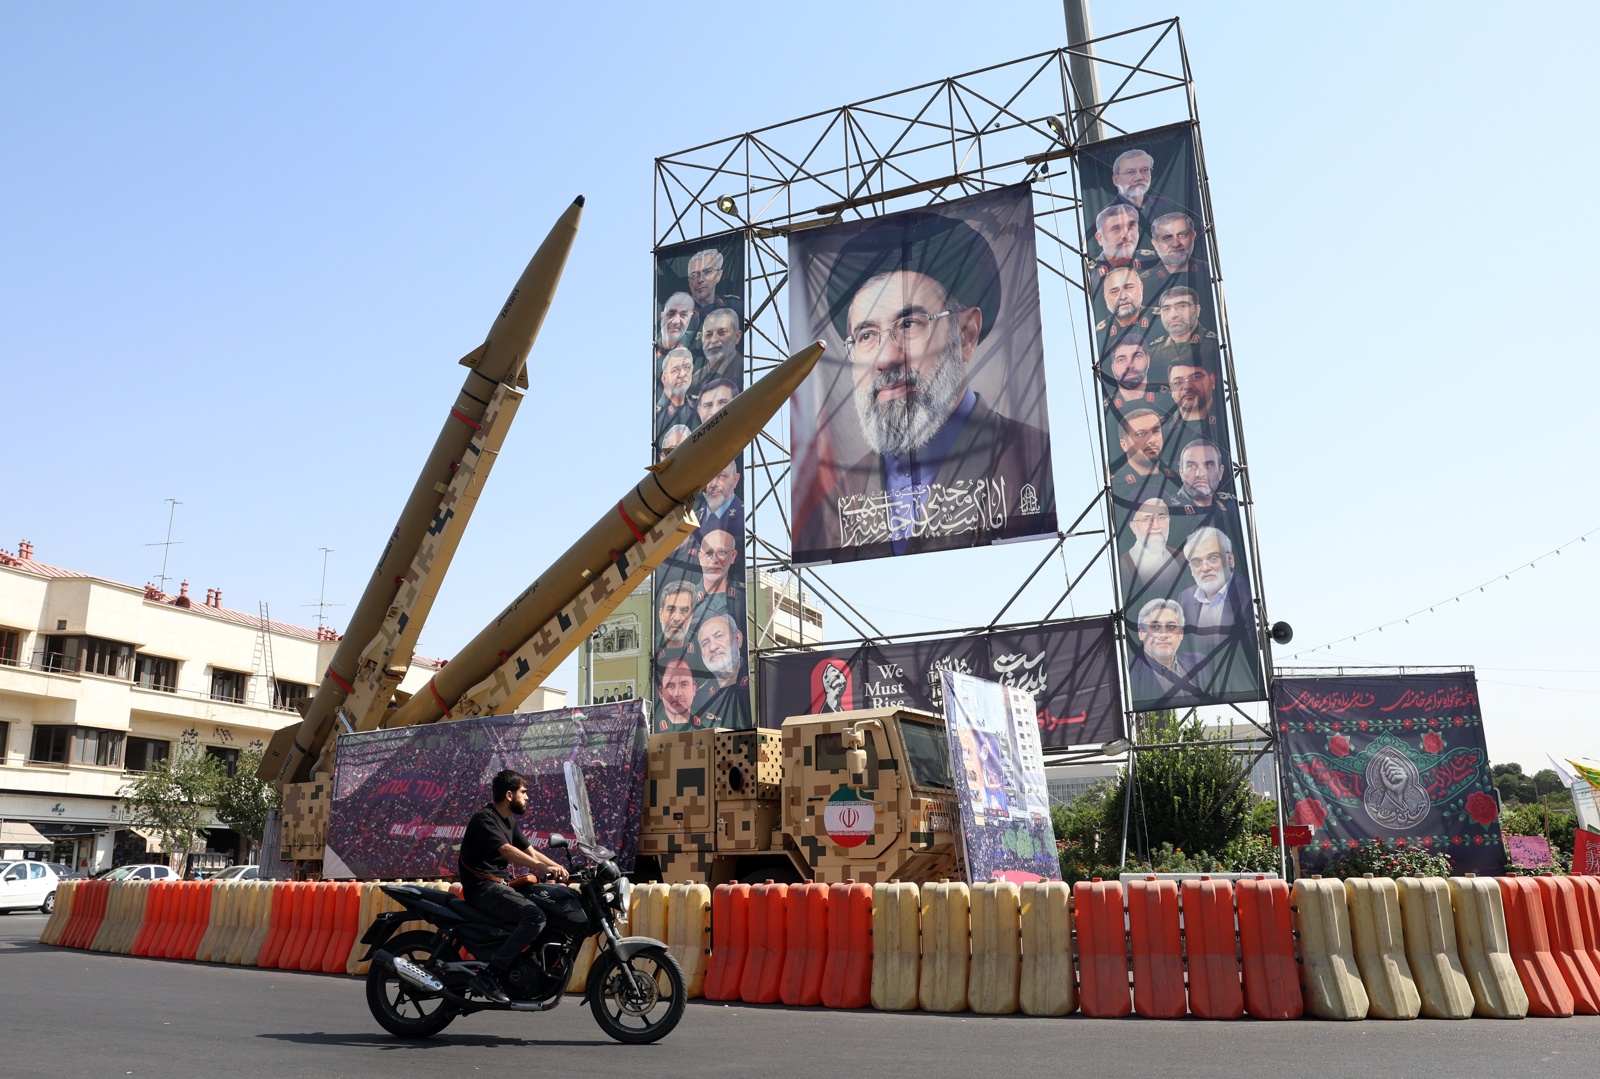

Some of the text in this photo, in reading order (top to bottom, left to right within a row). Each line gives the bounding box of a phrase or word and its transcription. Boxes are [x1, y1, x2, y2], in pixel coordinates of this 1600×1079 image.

[691, 410, 728, 443] ZA795214
[877, 663, 904, 680] We
[864, 682, 905, 697] Must
[872, 697, 905, 709] Rise
[414, 780, 448, 799] KILL
